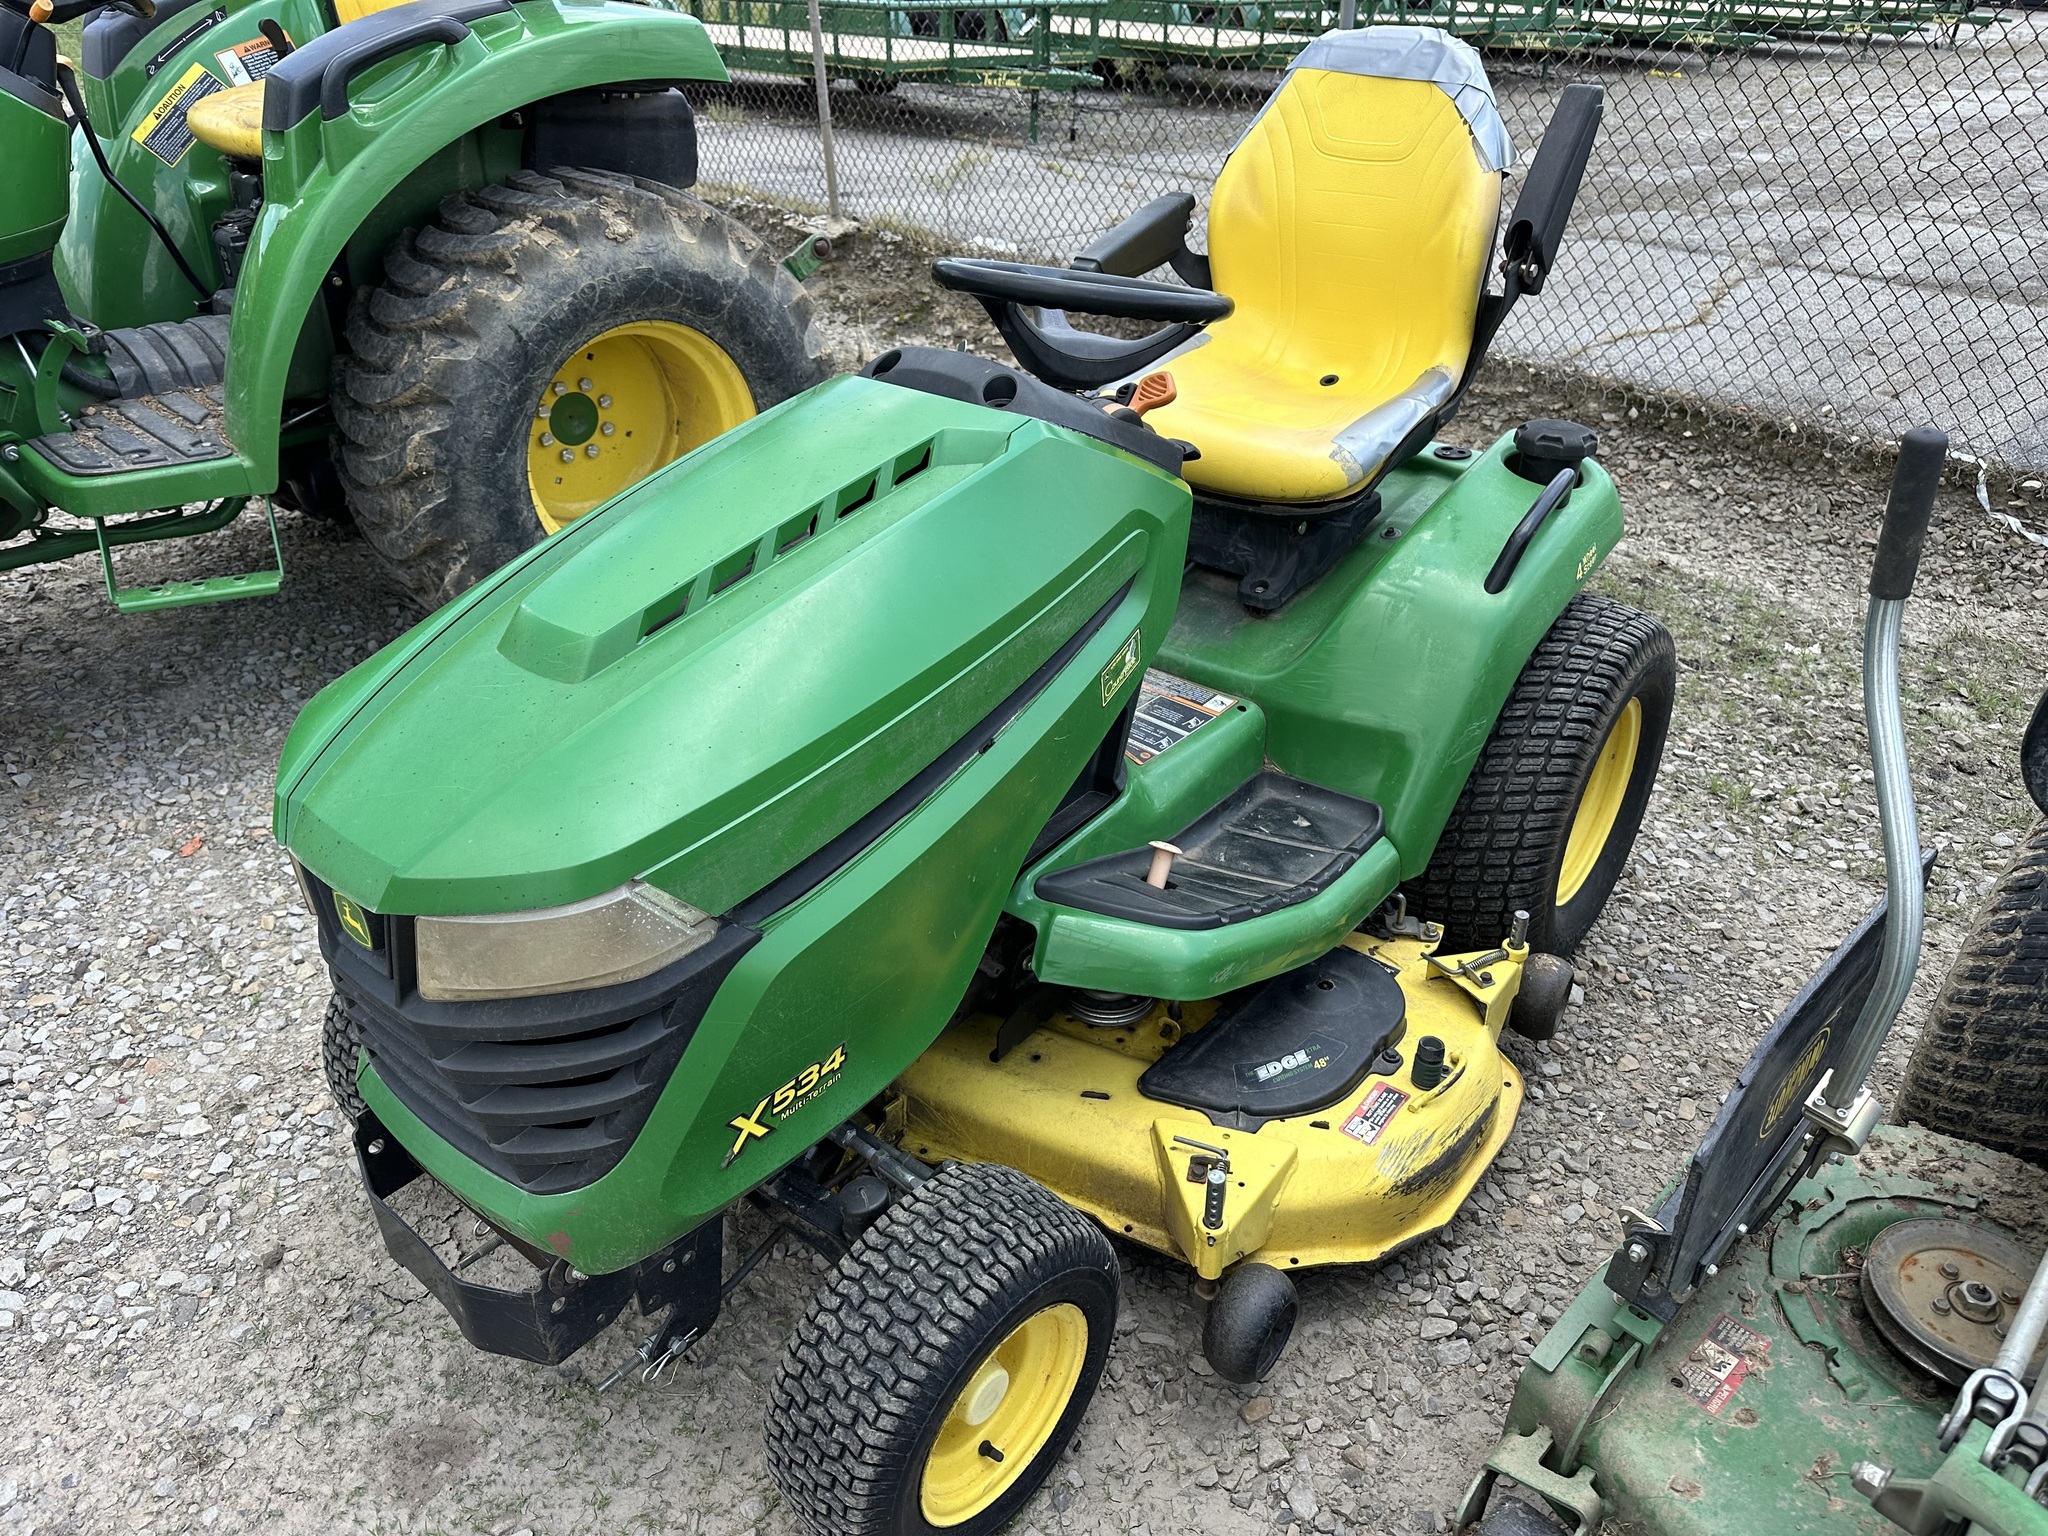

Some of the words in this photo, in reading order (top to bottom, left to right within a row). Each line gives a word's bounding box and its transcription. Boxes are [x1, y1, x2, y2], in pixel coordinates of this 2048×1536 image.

[249, 40, 272, 52] WARN
[158, 83, 187, 115] CAUTION
[1576, 562, 1583, 582] 4
[1254, 1049, 1310, 1082] EDGE
[725, 1043, 847, 1166] X534
[780, 1072, 842, 1121] Multi-Terrain
[1706, 1389, 1730, 1413] PELIGRO
